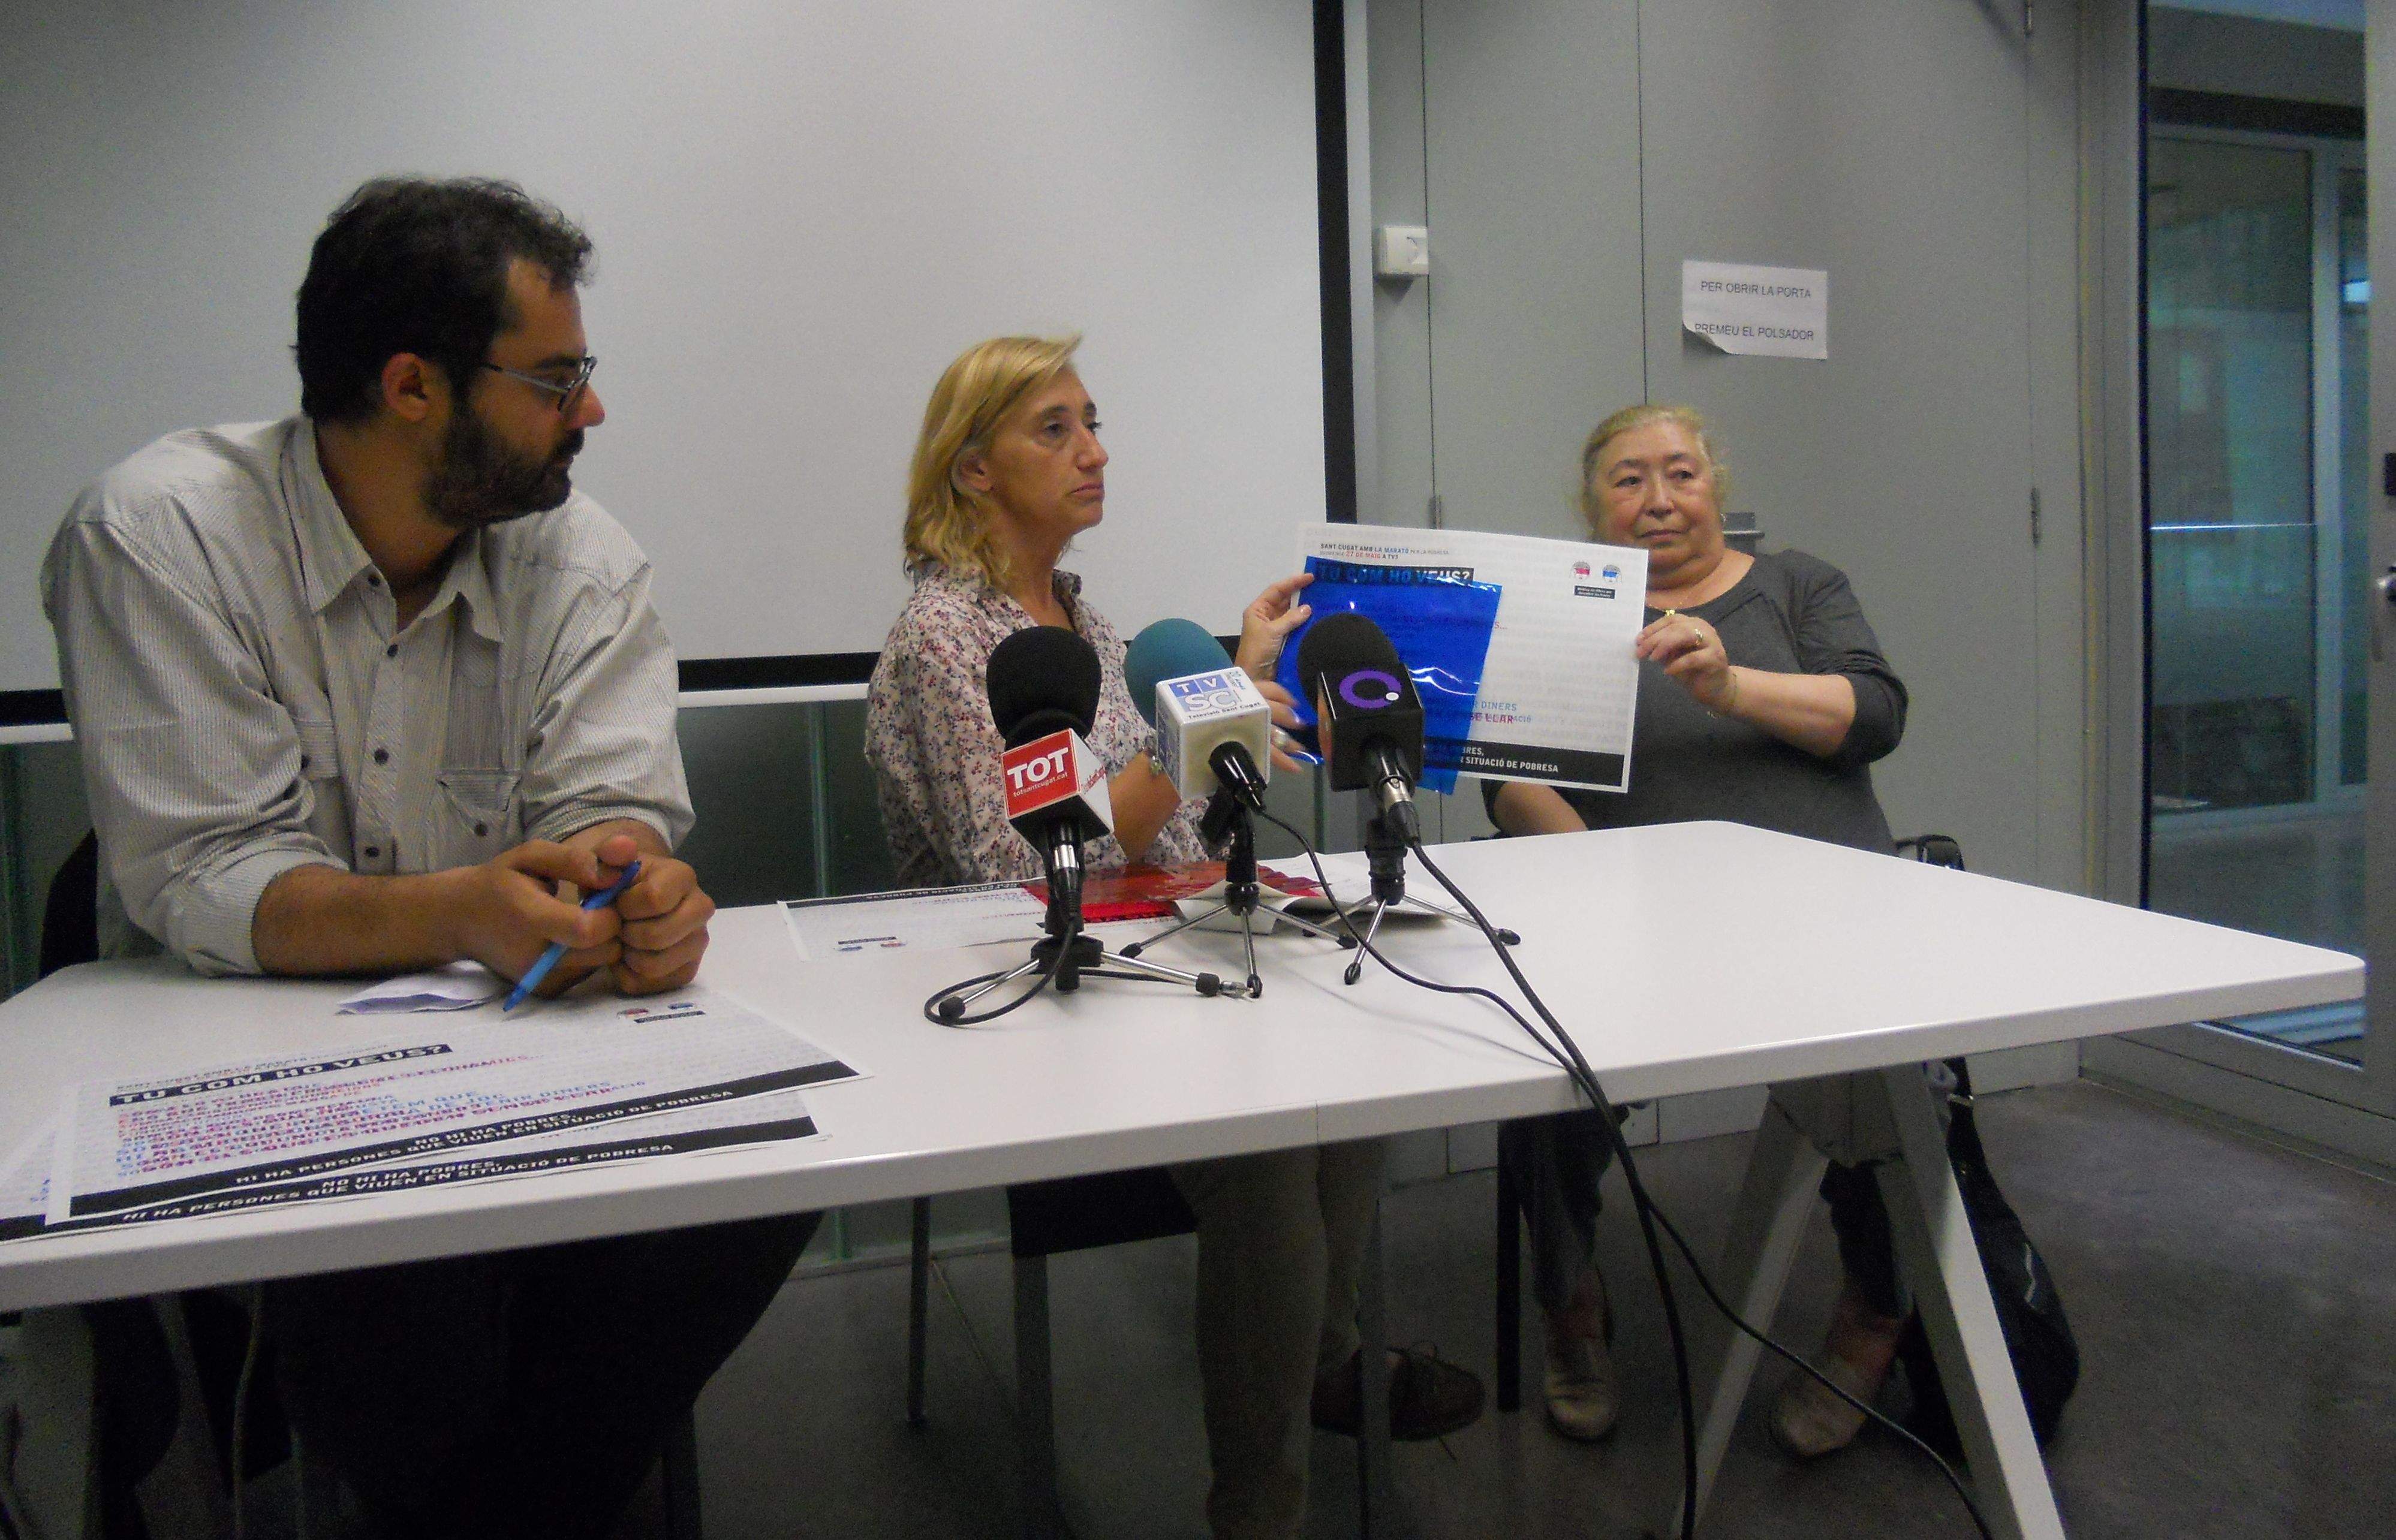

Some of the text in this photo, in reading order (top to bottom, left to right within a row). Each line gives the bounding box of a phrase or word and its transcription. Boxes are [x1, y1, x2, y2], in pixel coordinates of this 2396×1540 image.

[1700, 281, 1811, 299] PER OBRIR LA PORTA
[1743, 328, 1754, 337] EL
[1758, 327, 1814, 340] POLSADOR
[1185, 691, 1236, 711] SC
[1481, 701, 1517, 712] DINERS
[1007, 747, 1068, 789] TOT
[1465, 757, 1559, 773] SITUACIÓ DE POBRESA
[1013, 771, 1068, 798] totsantcugat.cat
[117, 1090, 165, 1103] TU
[182, 1074, 261, 1093] COM
[276, 1065, 323, 1078] HO
[332, 1045, 442, 1068] VEUS?
[656, 1090, 733, 1108] POBRESA
[123, 1212, 148, 1220] HI
[153, 1207, 181, 1217] HA
[189, 1191, 300, 1213] PERSONES
[307, 1186, 348, 1197] QUE
[425, 1173, 451, 1182] EN
[587, 1144, 674, 1161] POBRESA
[322, 1179, 350, 1188] NO
[384, 1171, 411, 1180] HA
